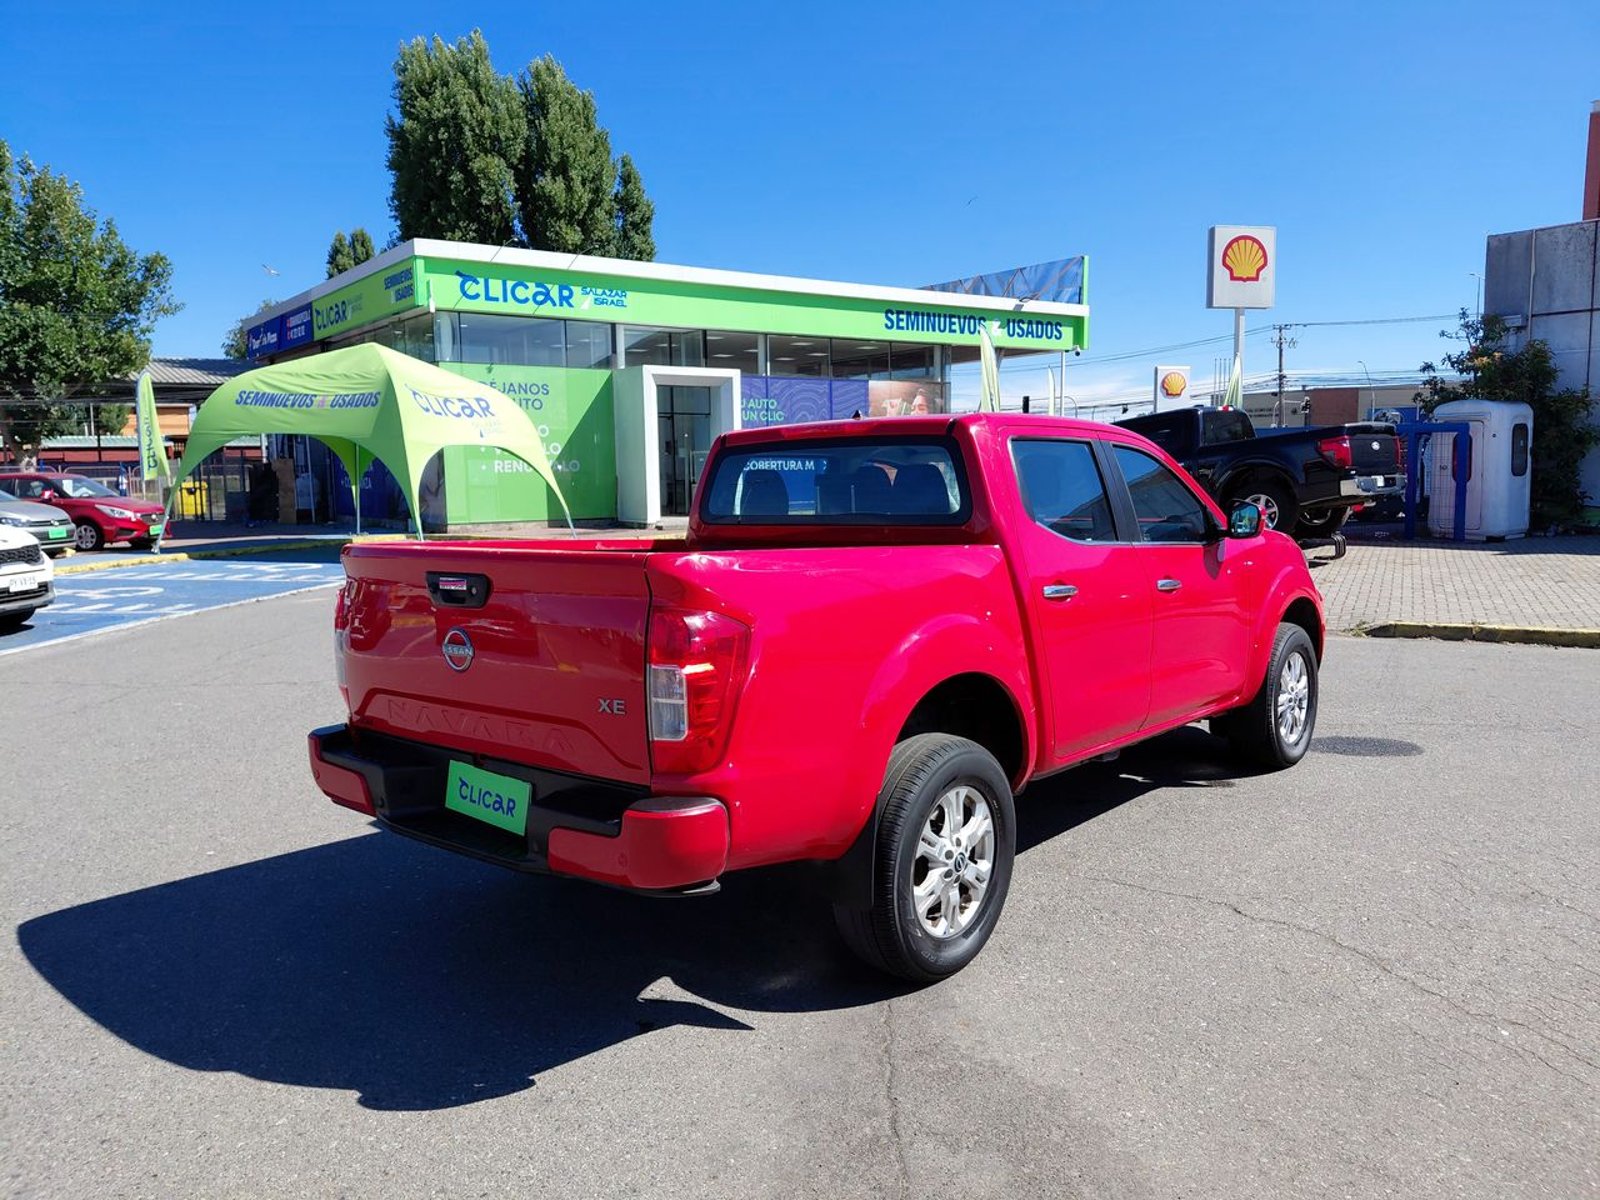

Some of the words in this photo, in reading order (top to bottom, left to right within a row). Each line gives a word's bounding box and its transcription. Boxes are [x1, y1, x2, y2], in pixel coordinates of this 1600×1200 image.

[580, 286, 628, 299] SALAZAR
[884, 308, 987, 336] SEMINUEVOS
[1006, 317, 1063, 341] USADOS
[235, 390, 317, 408] SEMINUEVOS
[329, 391, 381, 409] USADOS
[747, 398, 778, 410] AUTO
[742, 410, 757, 421] UN
[760, 410, 785, 422] CLIC
[597, 698, 626, 716] XE
[387, 698, 575, 752] NAVARA
